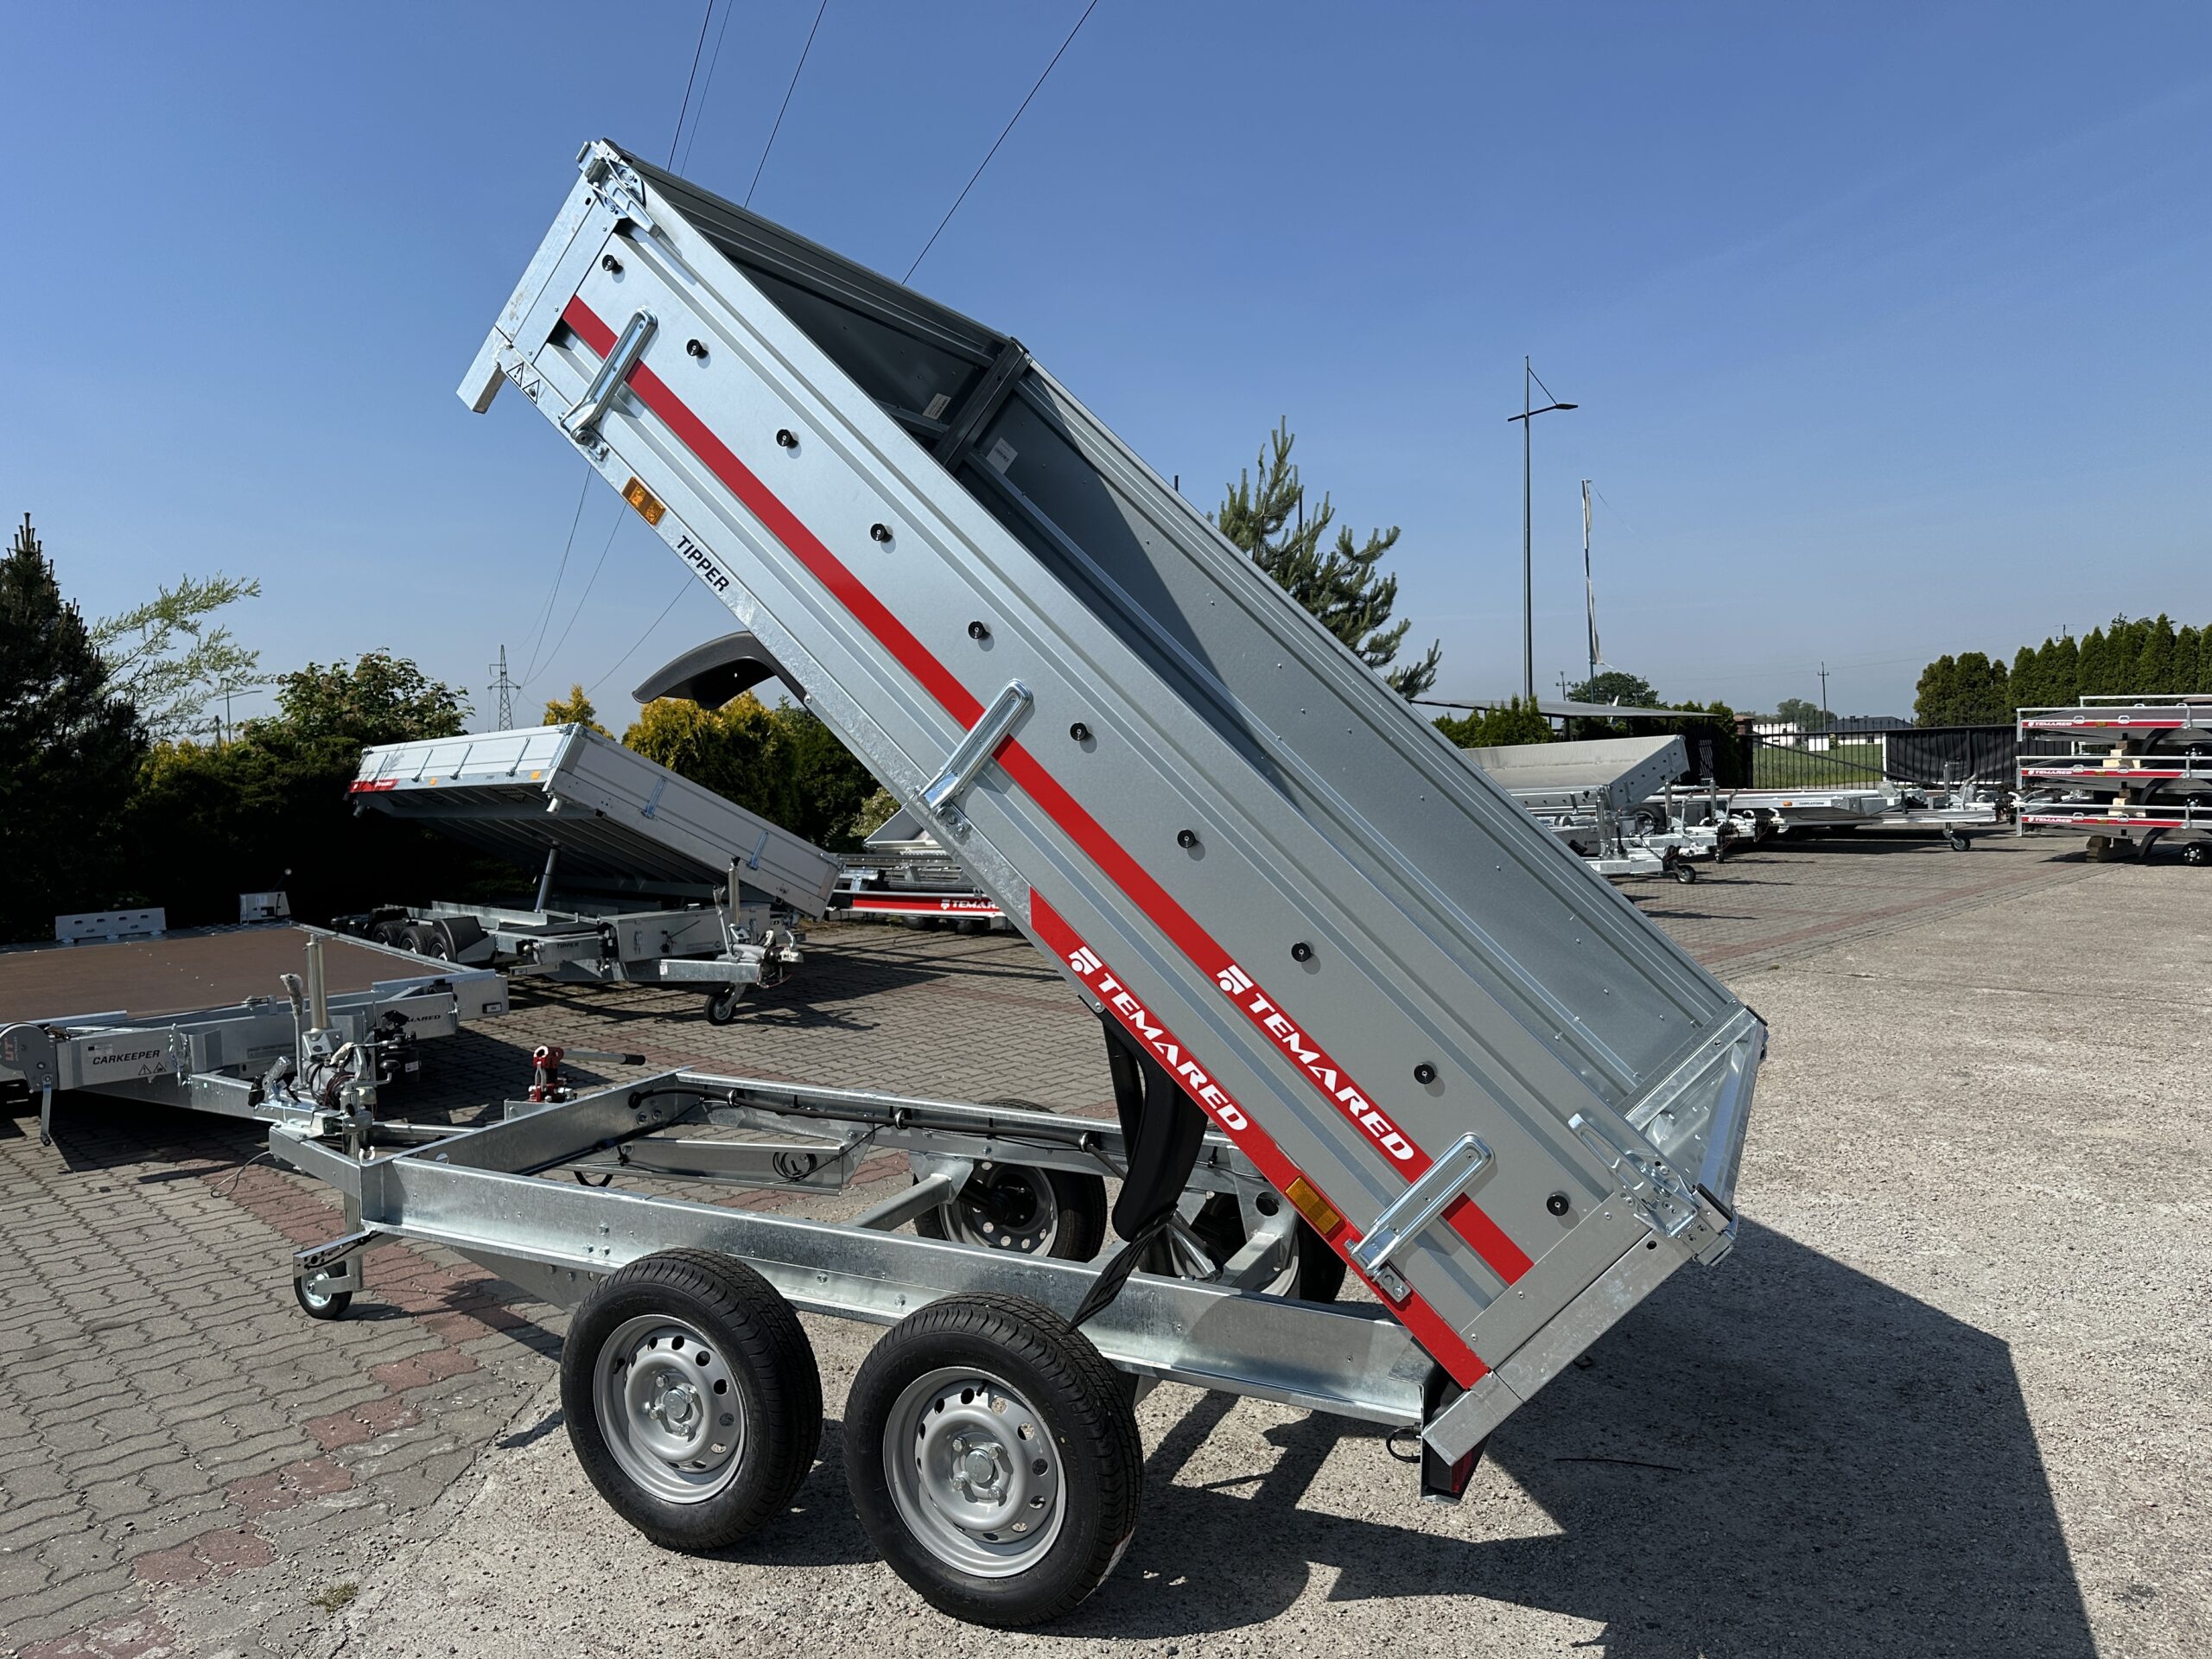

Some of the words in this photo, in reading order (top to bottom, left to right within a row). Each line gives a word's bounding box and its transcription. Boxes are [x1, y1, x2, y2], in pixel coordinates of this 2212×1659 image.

[677, 534, 730, 593] TIPPER
[92, 1049, 161, 1065] CARKEEPER
[1098, 972, 1249, 1131] TEMARED
[1248, 991, 1414, 1161] TEMARED
